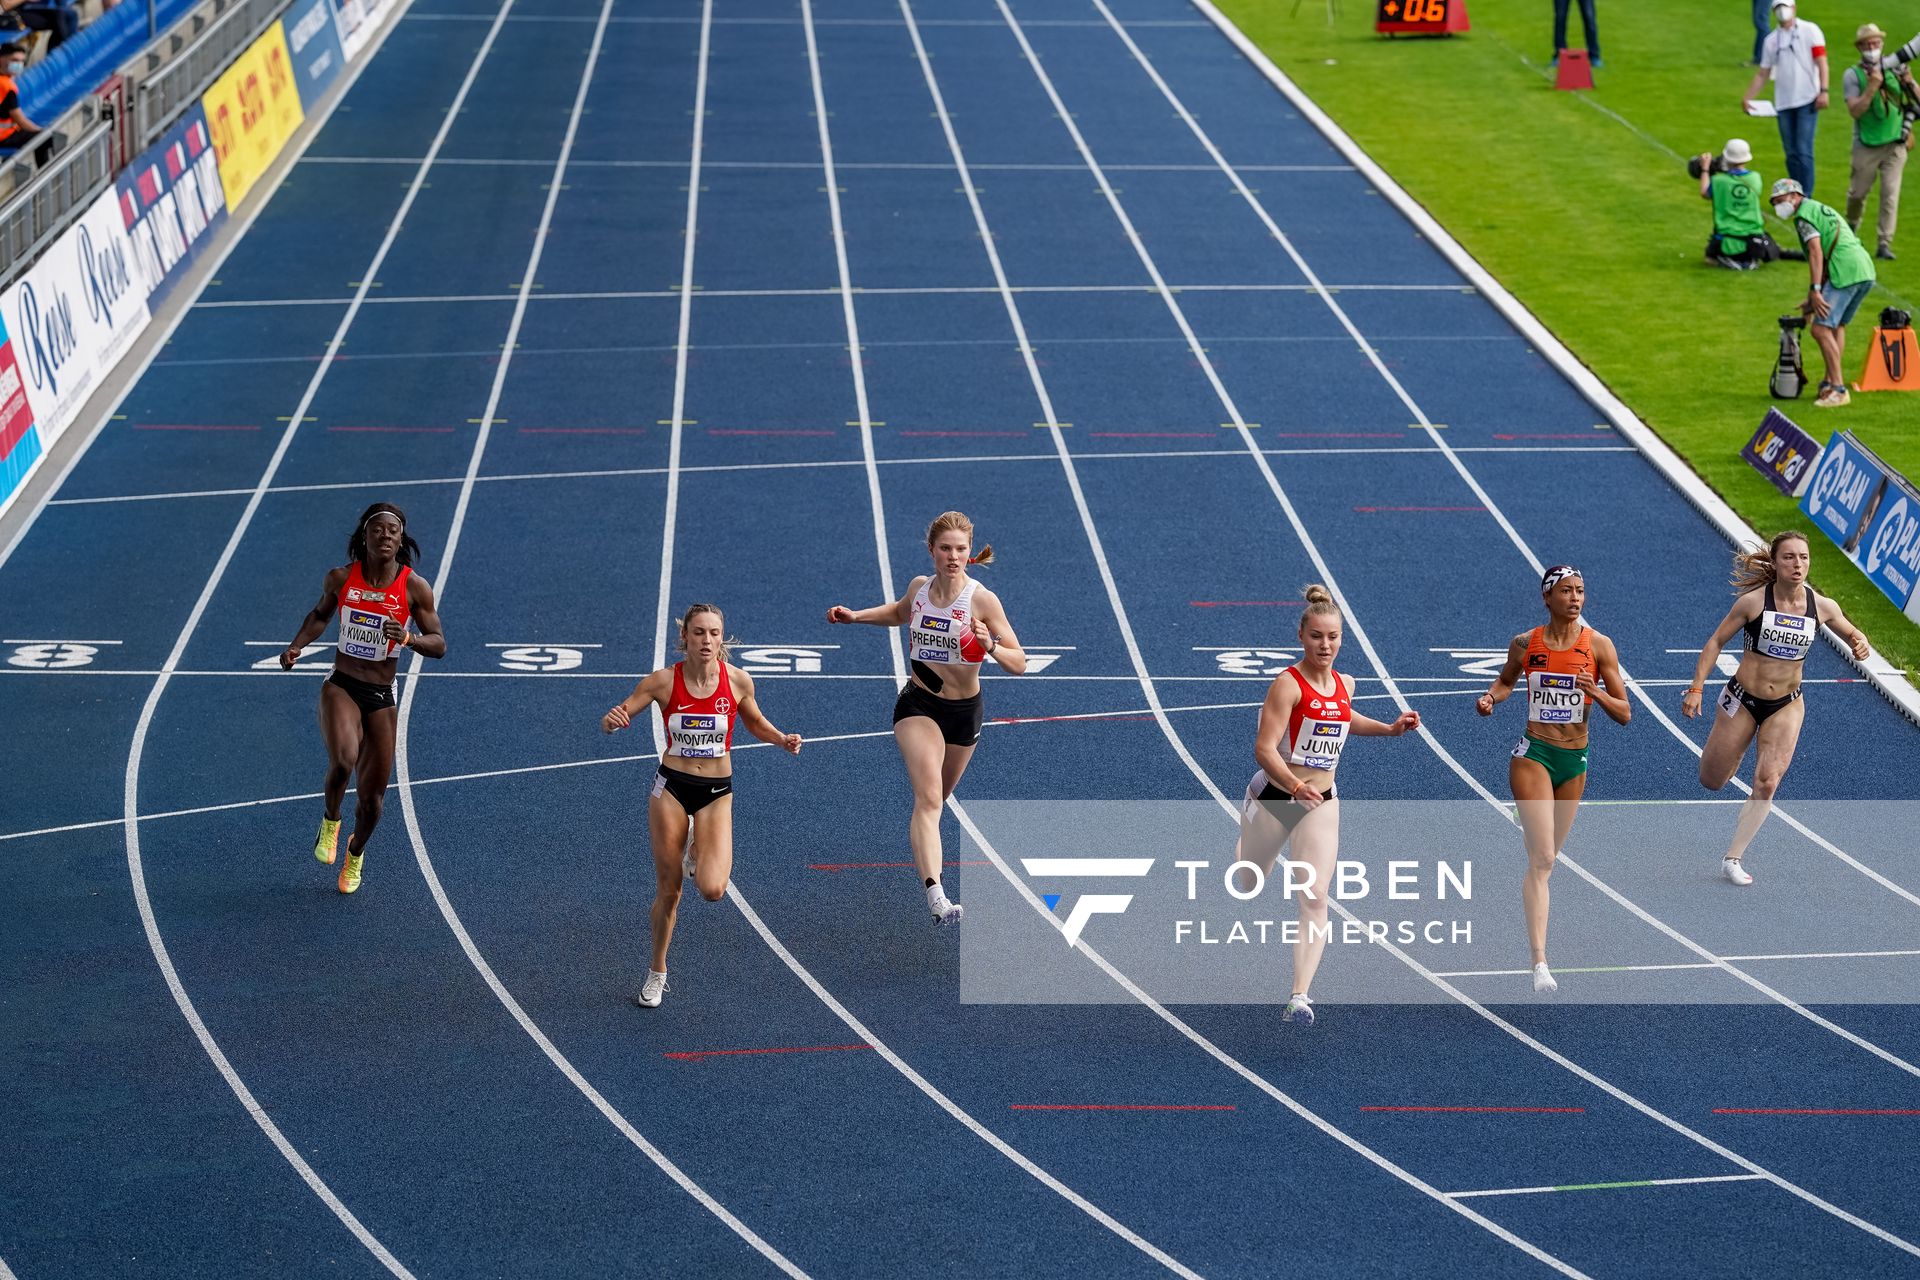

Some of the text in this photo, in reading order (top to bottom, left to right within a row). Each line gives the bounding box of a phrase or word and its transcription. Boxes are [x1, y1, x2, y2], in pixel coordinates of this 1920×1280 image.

[1887, 340, 1901, 377] 1
[1833, 460, 1870, 514] PLAN
[366, 618, 379, 626] GLS
[936, 622, 948, 630] GLS
[912, 631, 958, 649] PREPENS
[1762, 628, 1809, 647] SCHERZL
[7, 644, 99, 668] 8
[740, 648, 823, 672] 5
[1533, 691, 1581, 706] PINTO
[1722, 694, 1732, 711] 2
[672, 732, 724, 746] MONTAG
[1328, 727, 1339, 735] GLS
[1301, 739, 1342, 754] JUNK
